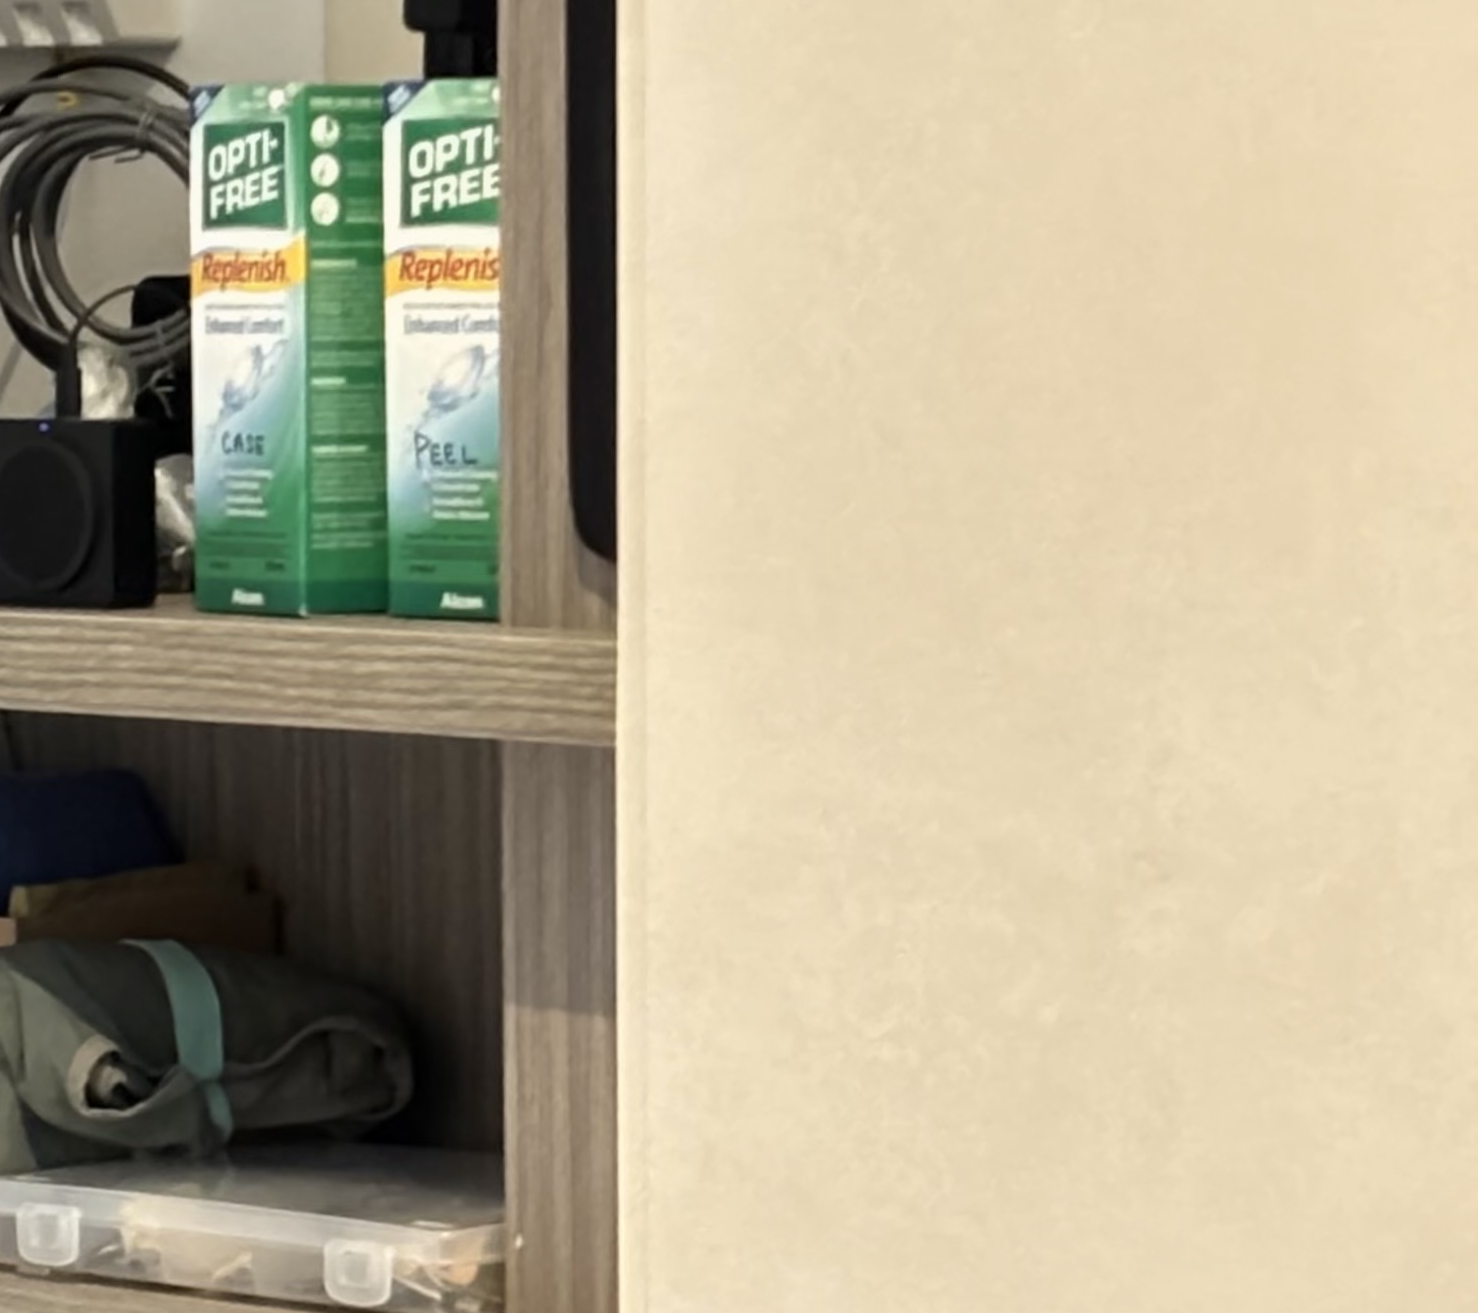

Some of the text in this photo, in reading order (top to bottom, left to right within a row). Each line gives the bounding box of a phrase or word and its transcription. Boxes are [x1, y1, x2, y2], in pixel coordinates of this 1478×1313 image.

[207, 128, 279, 182] OPTI-
[209, 166, 279, 220] FREE
[410, 164, 500, 218] FREE
[201, 249, 287, 291] Replenish
[399, 246, 500, 291] Replenis
[221, 431, 265, 456] CASE
[414, 431, 478, 468] PEEL
